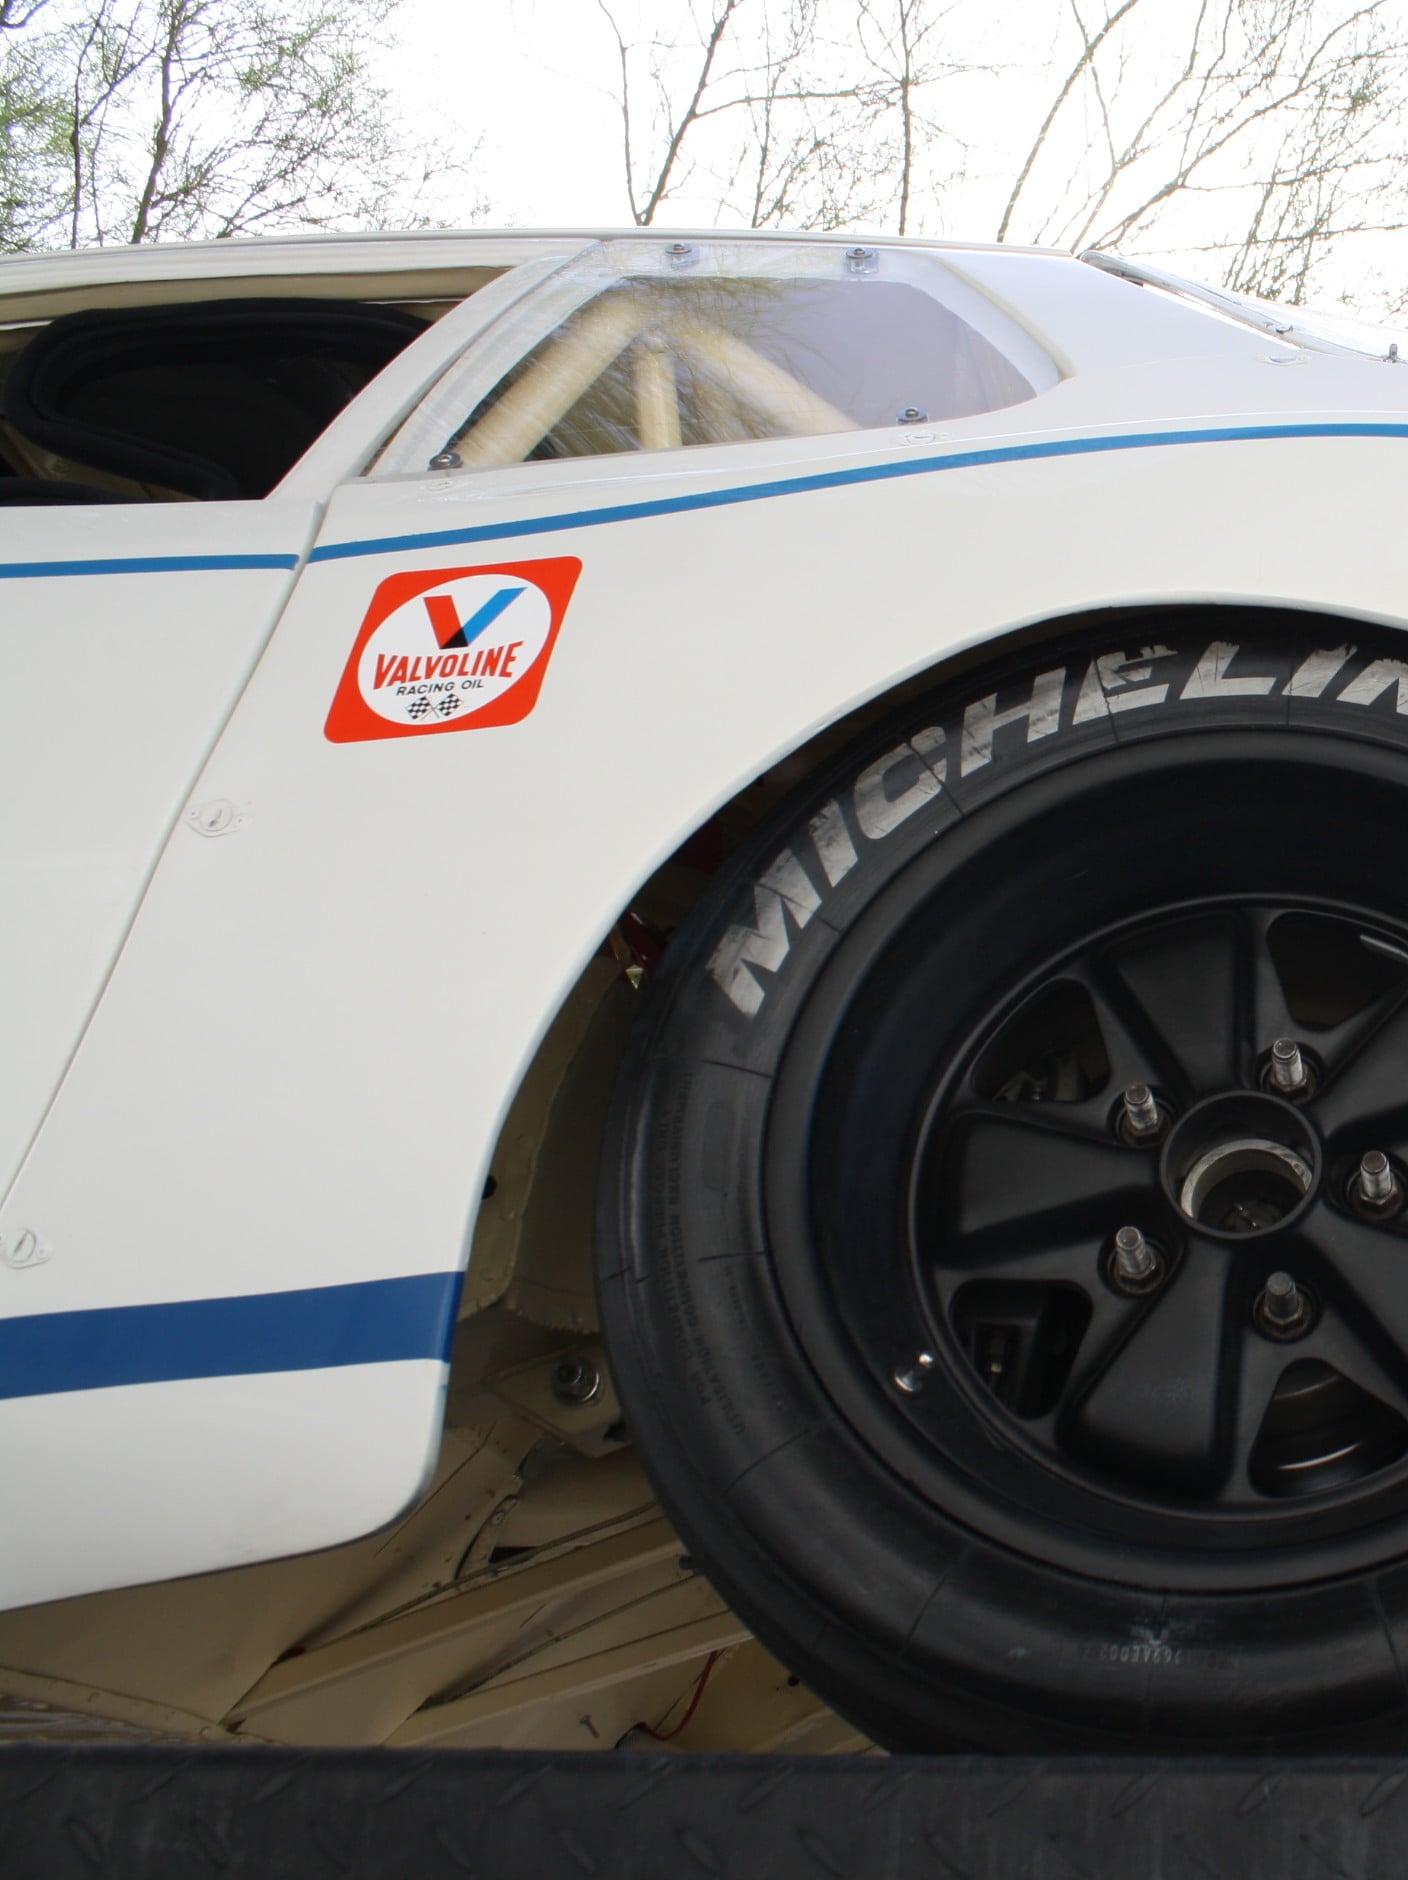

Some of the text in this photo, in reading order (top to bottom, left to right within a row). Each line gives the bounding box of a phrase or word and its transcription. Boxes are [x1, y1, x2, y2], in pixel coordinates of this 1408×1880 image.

[372, 640, 524, 690] VALVOLINE
[396, 678, 485, 697] RACING OIL
